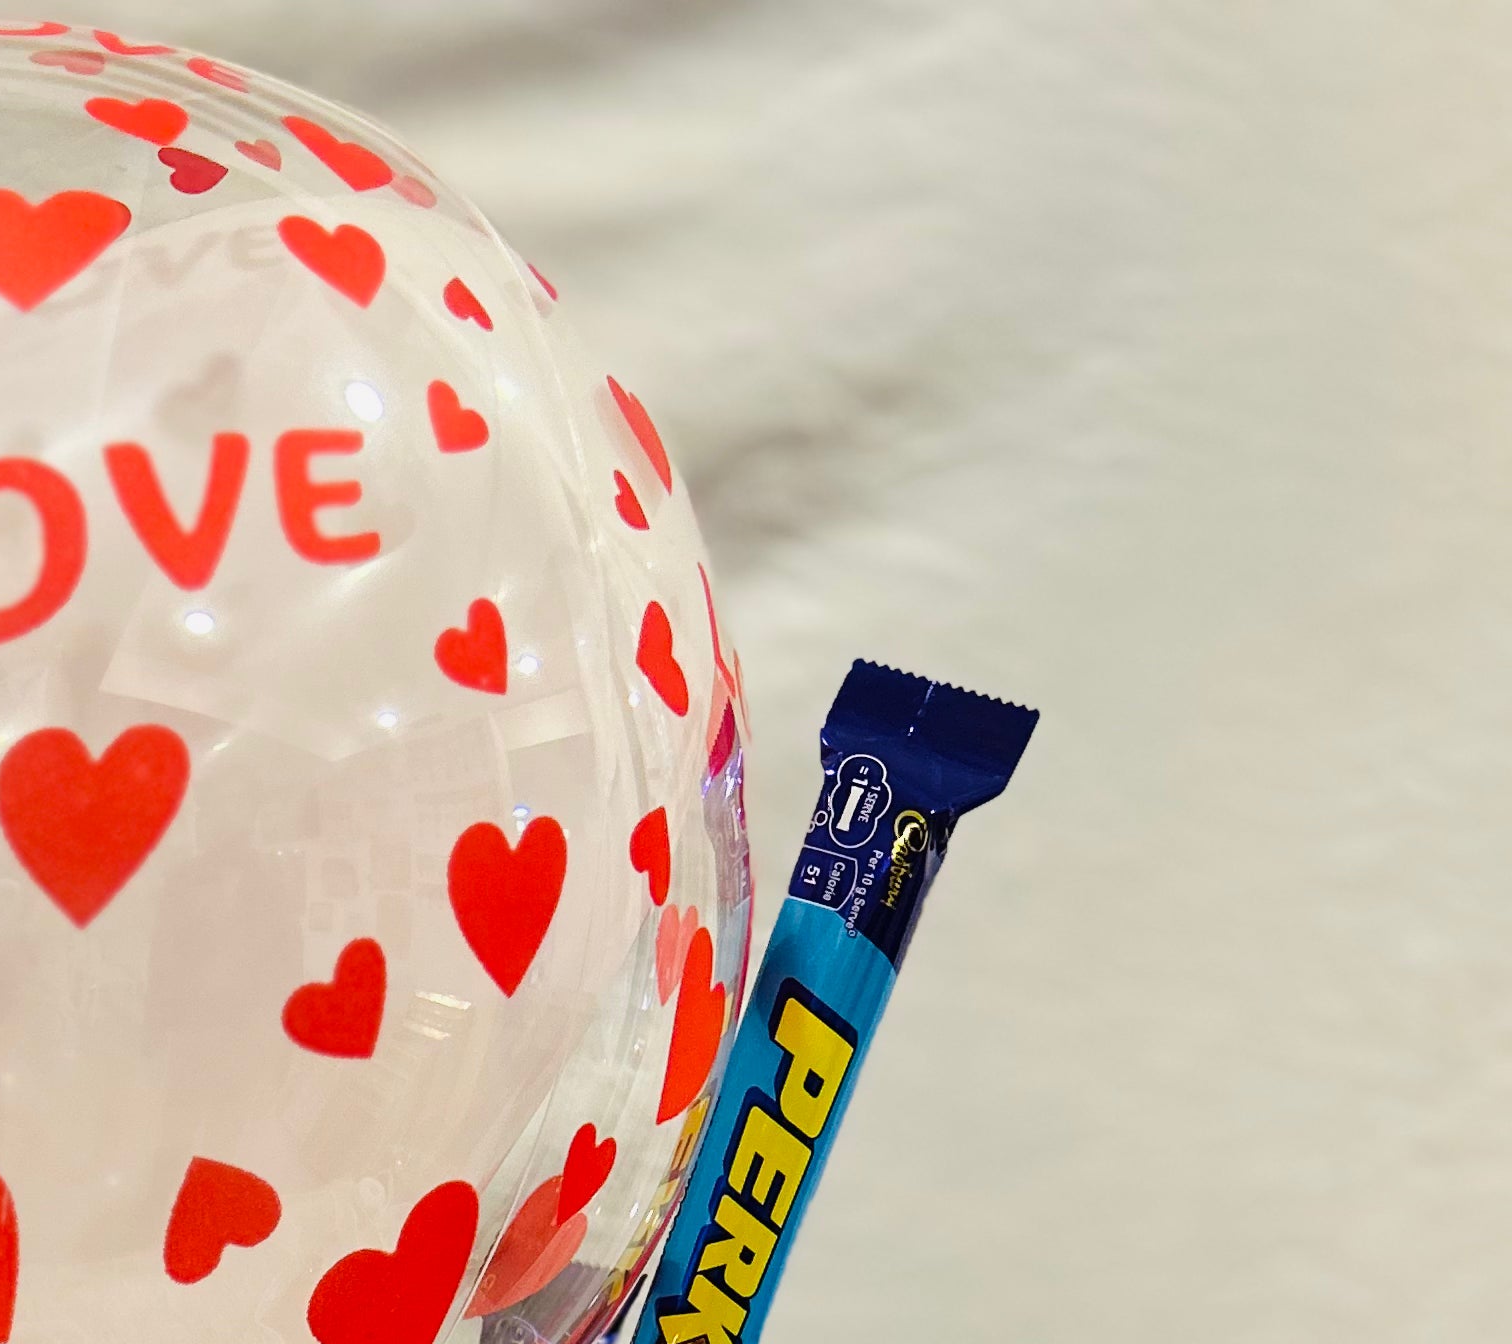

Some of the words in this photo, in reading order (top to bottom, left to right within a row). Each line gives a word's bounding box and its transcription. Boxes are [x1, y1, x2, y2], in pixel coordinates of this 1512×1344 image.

[858, 792, 879, 824] SERVE
[864, 849, 884, 871] Per
[803, 864, 821, 886] 51
[822, 861, 846, 902] Calorie
[862, 873, 874, 887] 10
